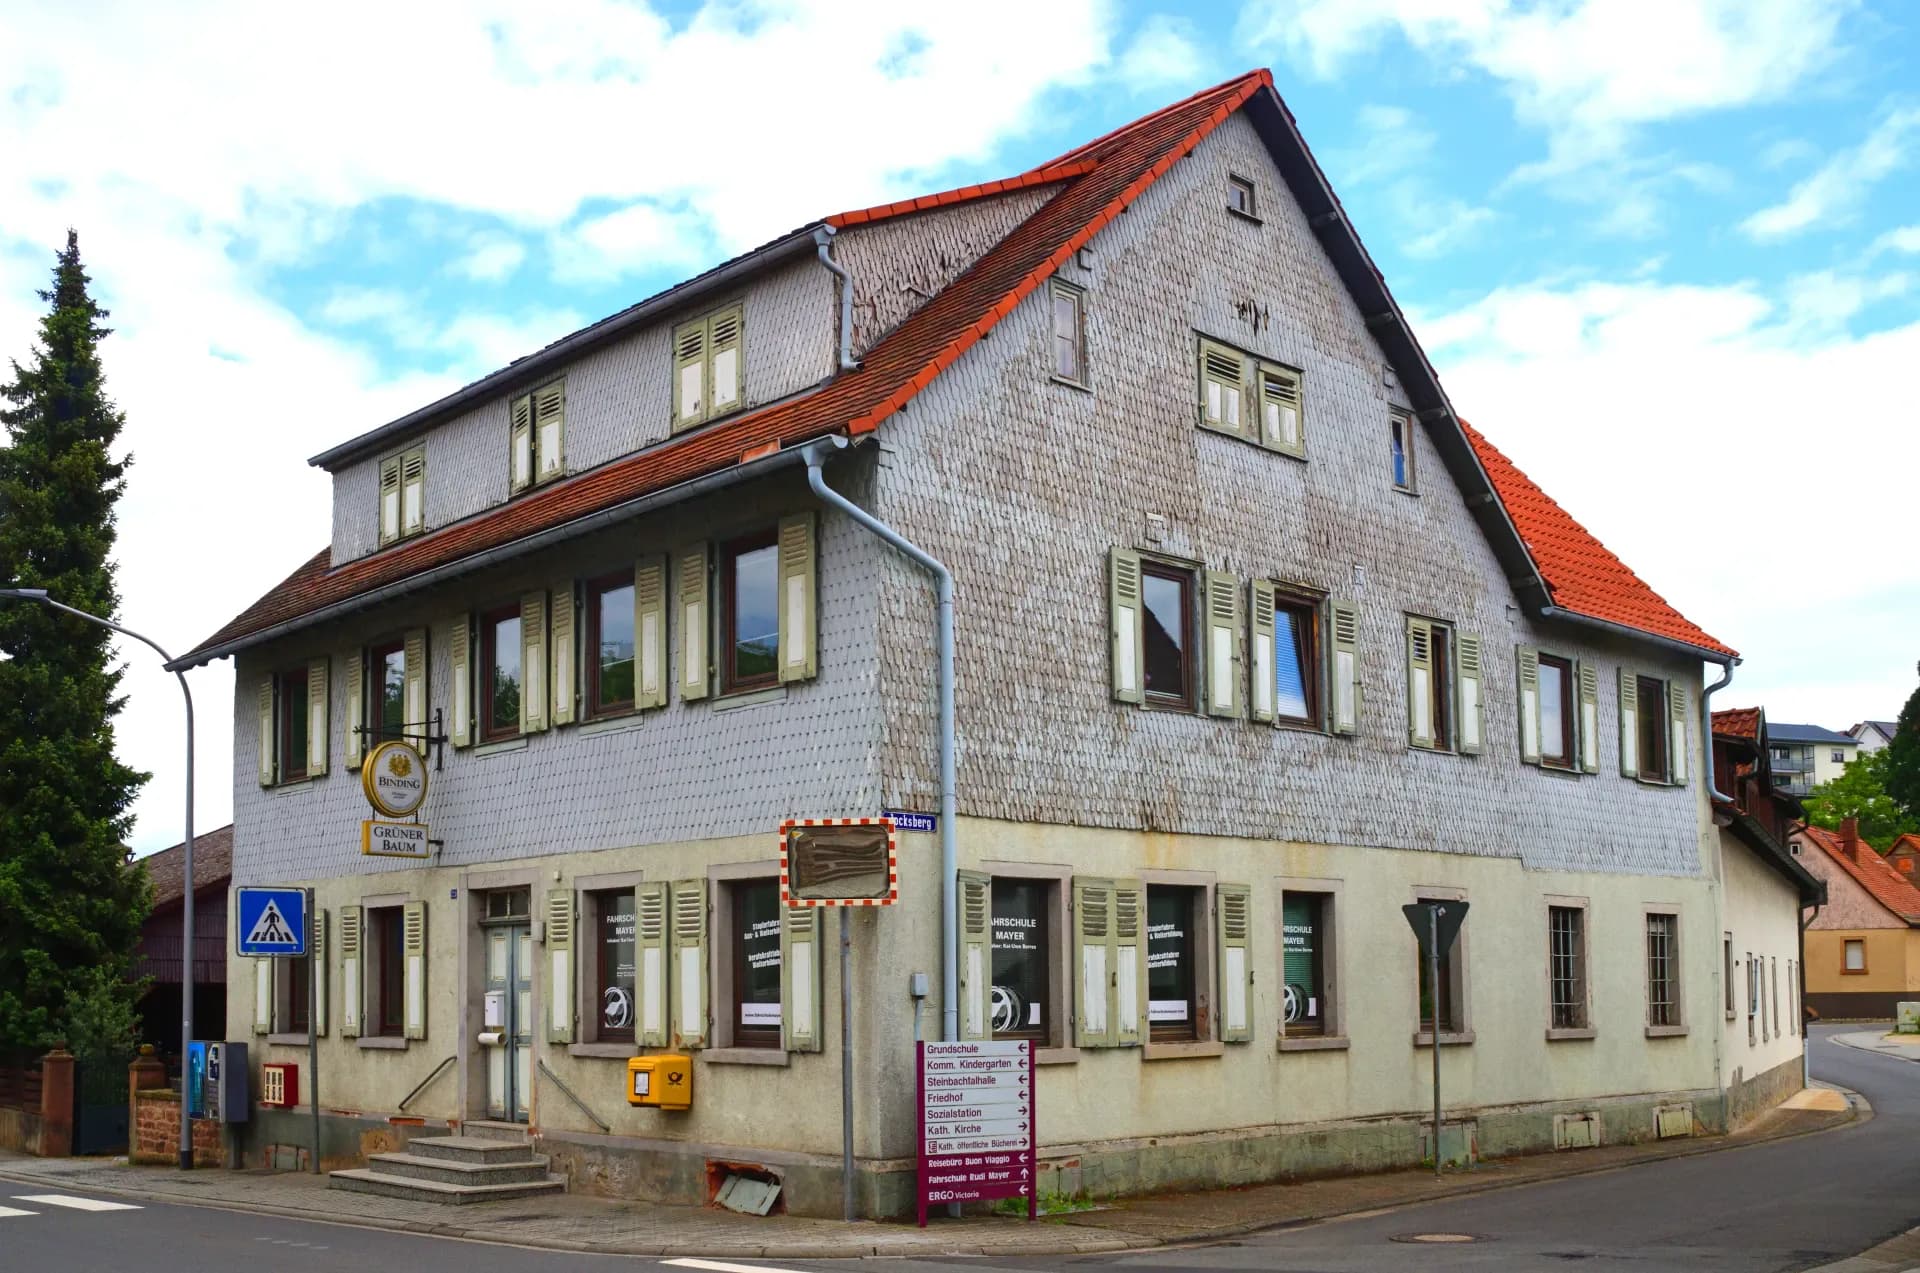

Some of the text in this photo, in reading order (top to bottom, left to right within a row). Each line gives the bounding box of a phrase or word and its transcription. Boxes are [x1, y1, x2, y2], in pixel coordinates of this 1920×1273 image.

[378, 776, 420, 790] BINDING
[373, 824, 424, 840] GRÜNER
[382, 840, 416, 852] BAUM
[606, 914, 635, 923] FAHRSCH
[995, 931, 1024, 940] MAYER
[927, 1044, 979, 1054] Grundschule
[927, 1059, 1012, 1071] Komm. Kindergarten
[927, 1075, 996, 1087] Steinbachtalhalle
[927, 1093, 964, 1103] Friedhof
[927, 1108, 982, 1119] Sozialstation
[928, 1124, 982, 1135] Kath. Kirche
[938, 1142, 954, 1151] Kath.
[928, 1155, 1010, 1168] Reisebüro Buon Viaggio
[928, 1171, 1010, 1184] Fahrschule Rudi Mayer
[928, 1190, 980, 1201] ERGO Victoria
